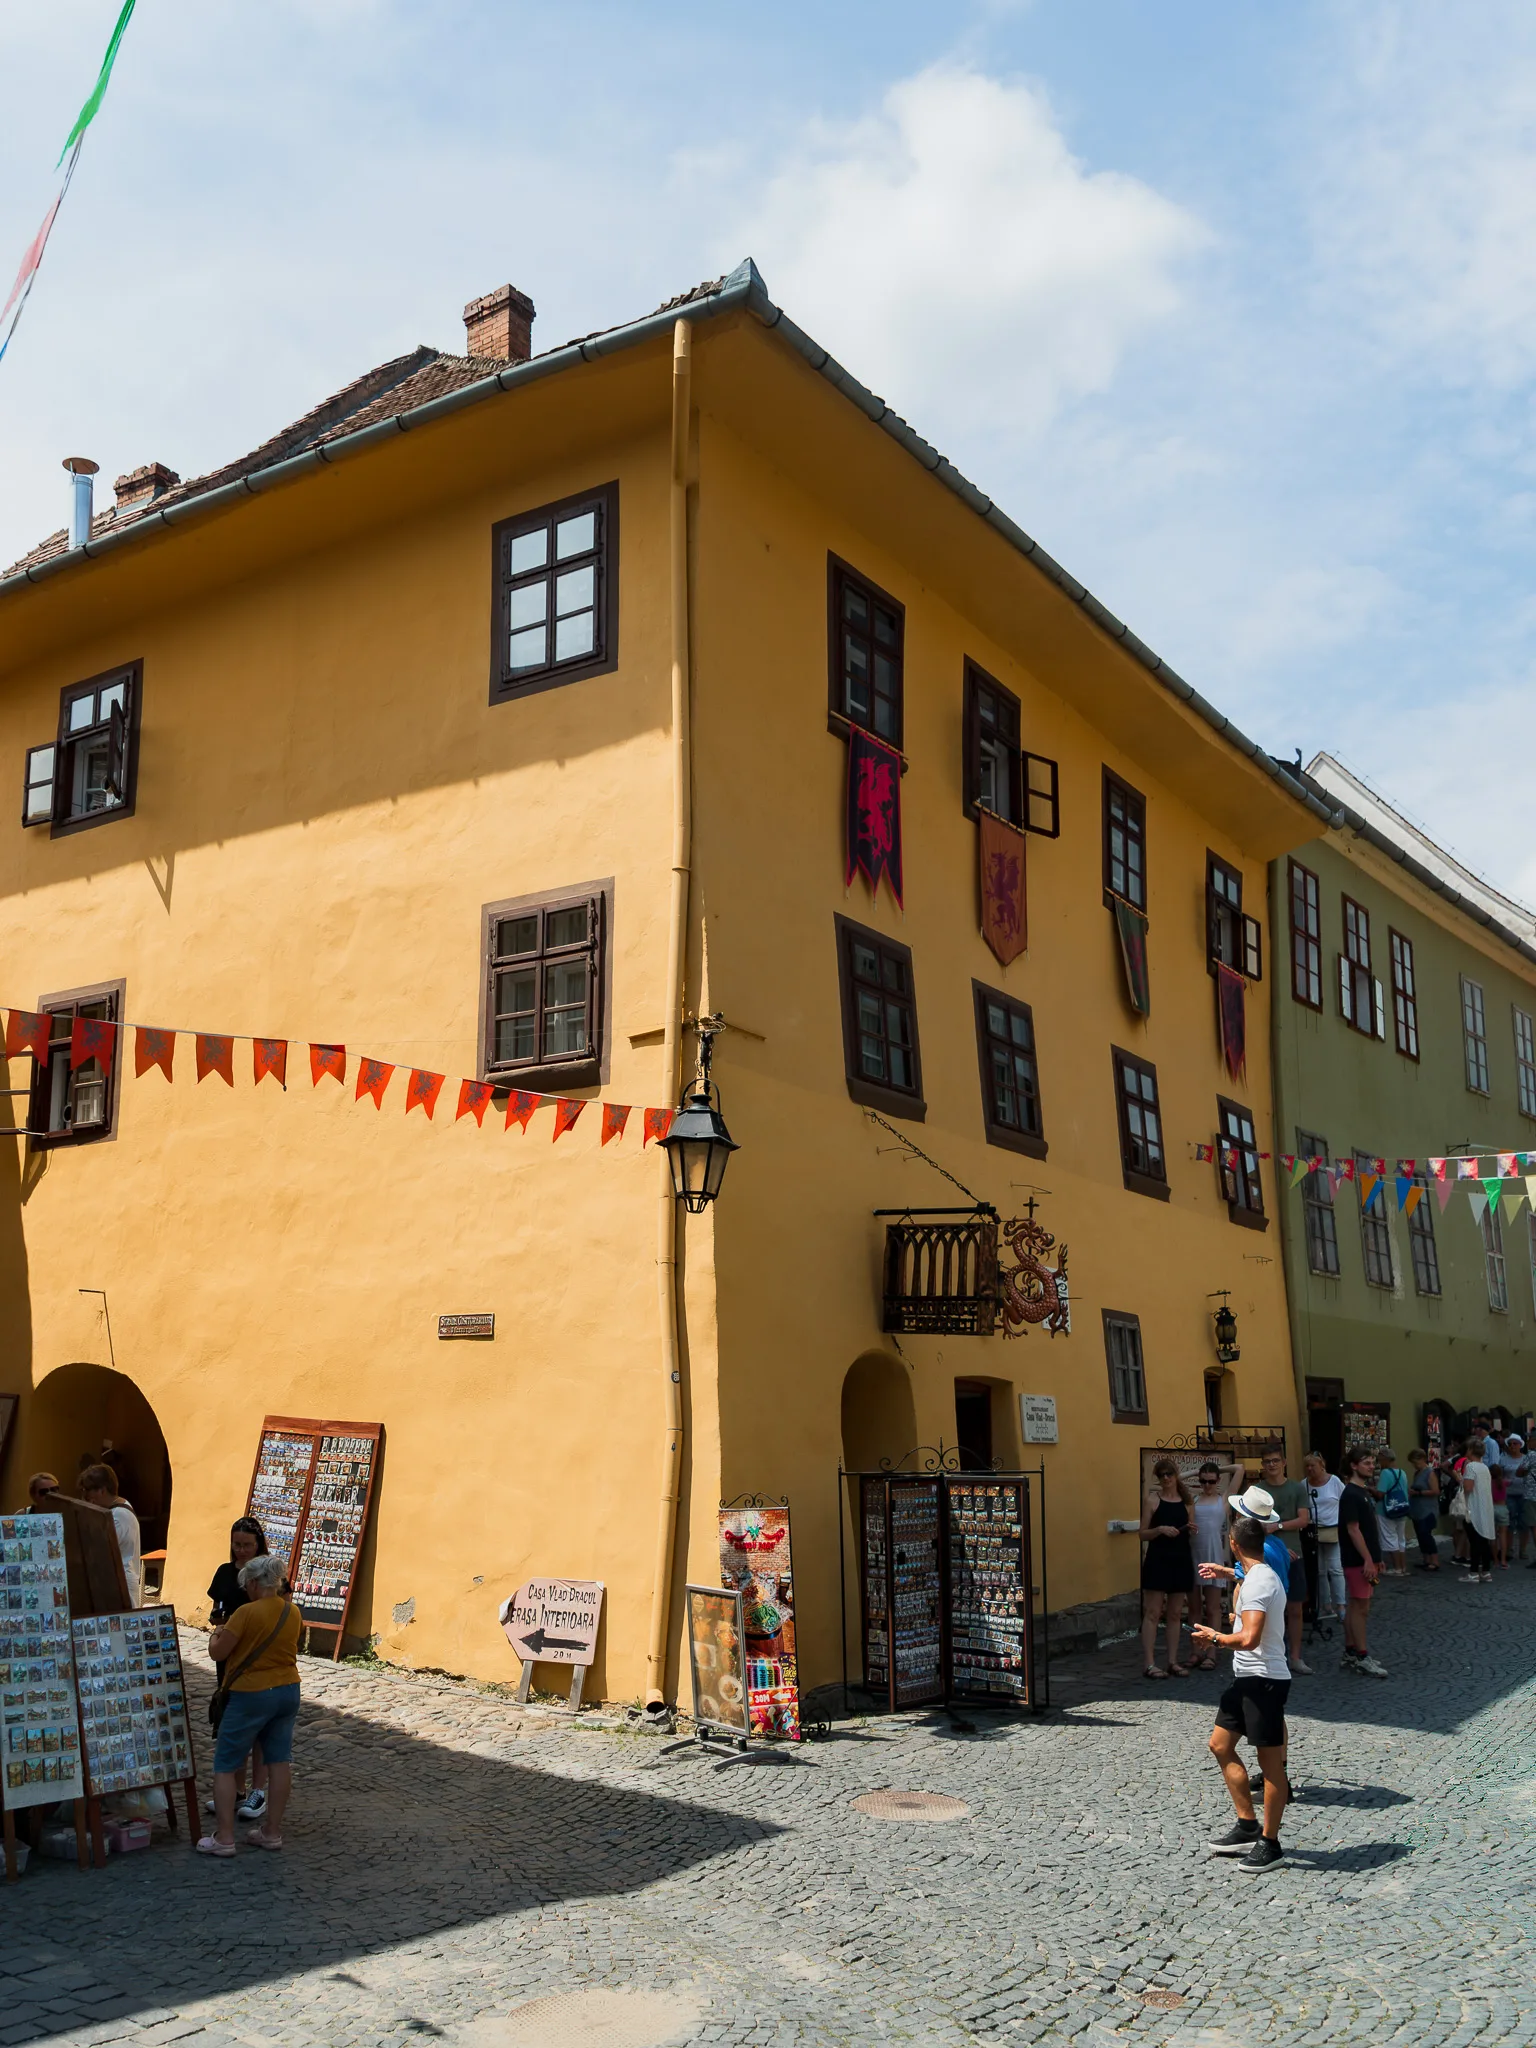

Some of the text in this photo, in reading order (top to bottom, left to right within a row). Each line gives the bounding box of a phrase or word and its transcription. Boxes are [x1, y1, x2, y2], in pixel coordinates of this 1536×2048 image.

[528, 1584, 597, 1605] CASA VLAD DRACUL
[509, 1604, 594, 1631] ERASA INTERIOARA
[553, 1650, 564, 1659] 20
[755, 1694, 770, 1703] 30M
